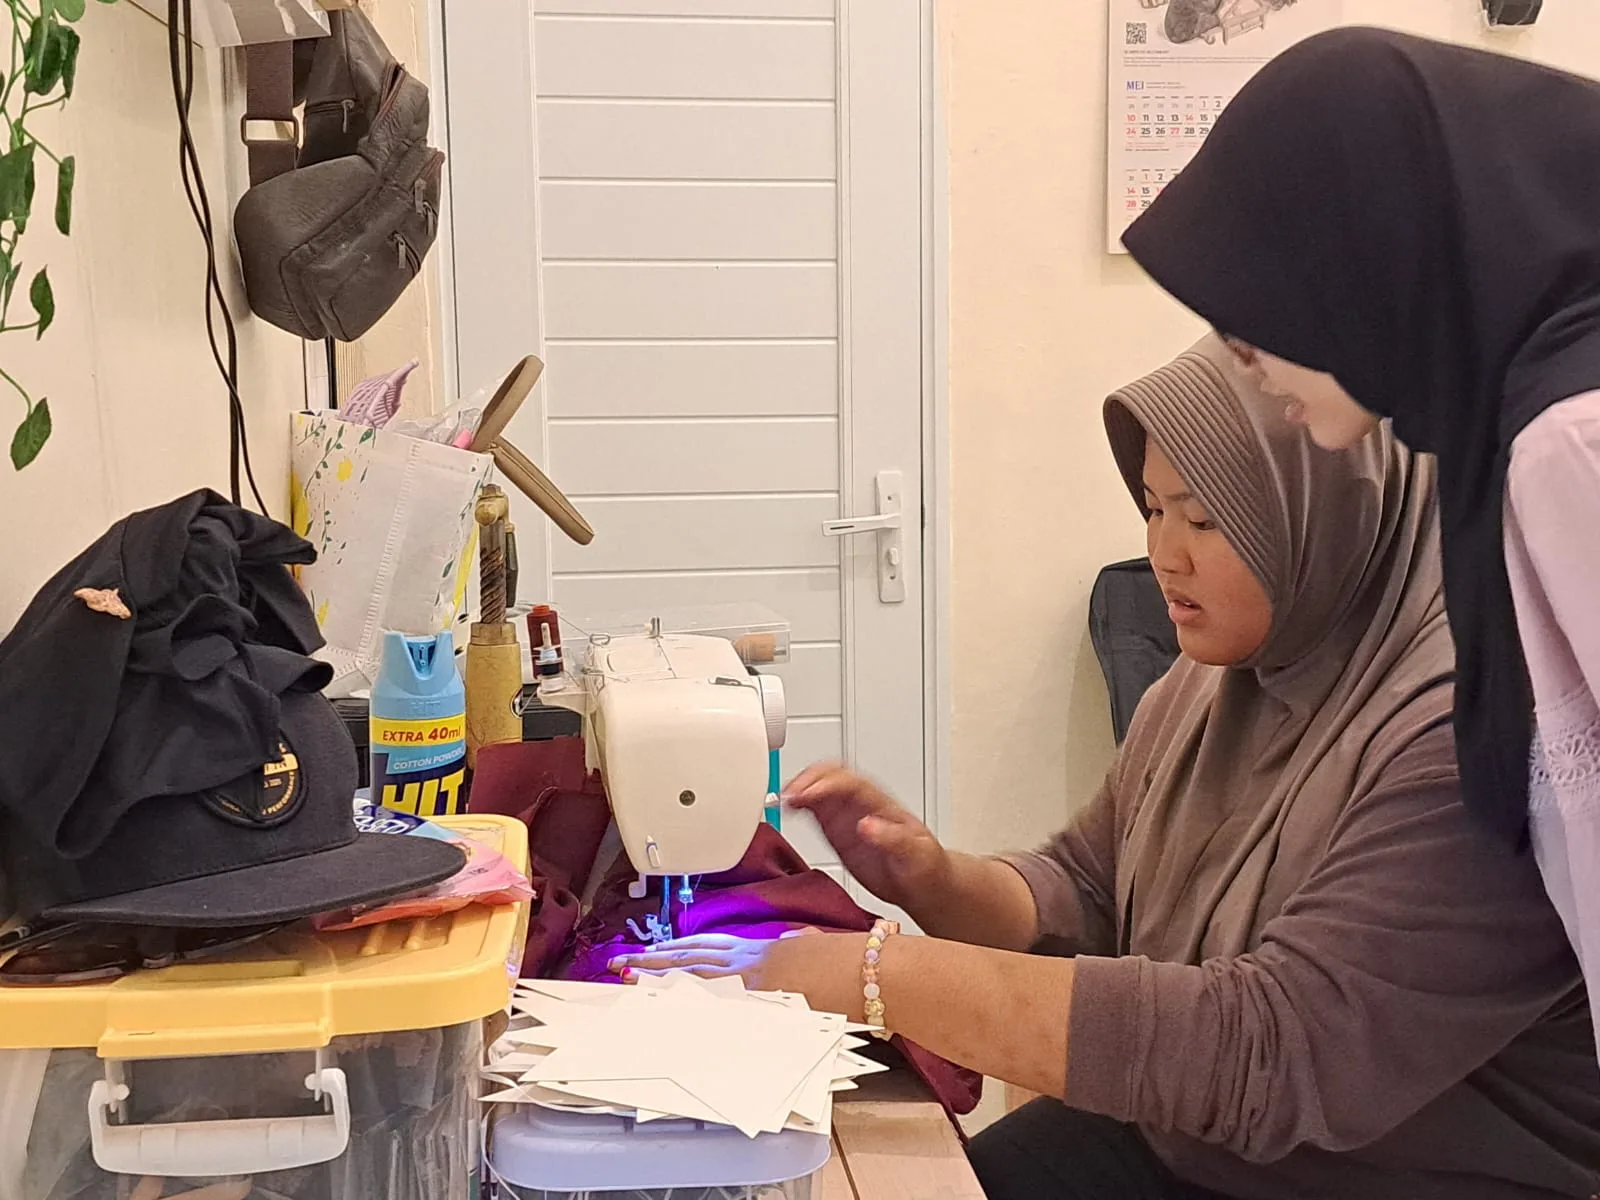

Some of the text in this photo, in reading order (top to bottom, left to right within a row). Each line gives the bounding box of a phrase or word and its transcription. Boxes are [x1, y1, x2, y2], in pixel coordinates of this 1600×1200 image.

[1126, 80, 1144, 90] MEI
[1126, 127, 1209, 135] 24 25 26 27 28 29
[1141, 200, 1151, 208] 29
[382, 726, 461, 742] EXTRA 40ml
[393, 757, 432, 770] COTTON
[382, 768, 464, 816] HIT
